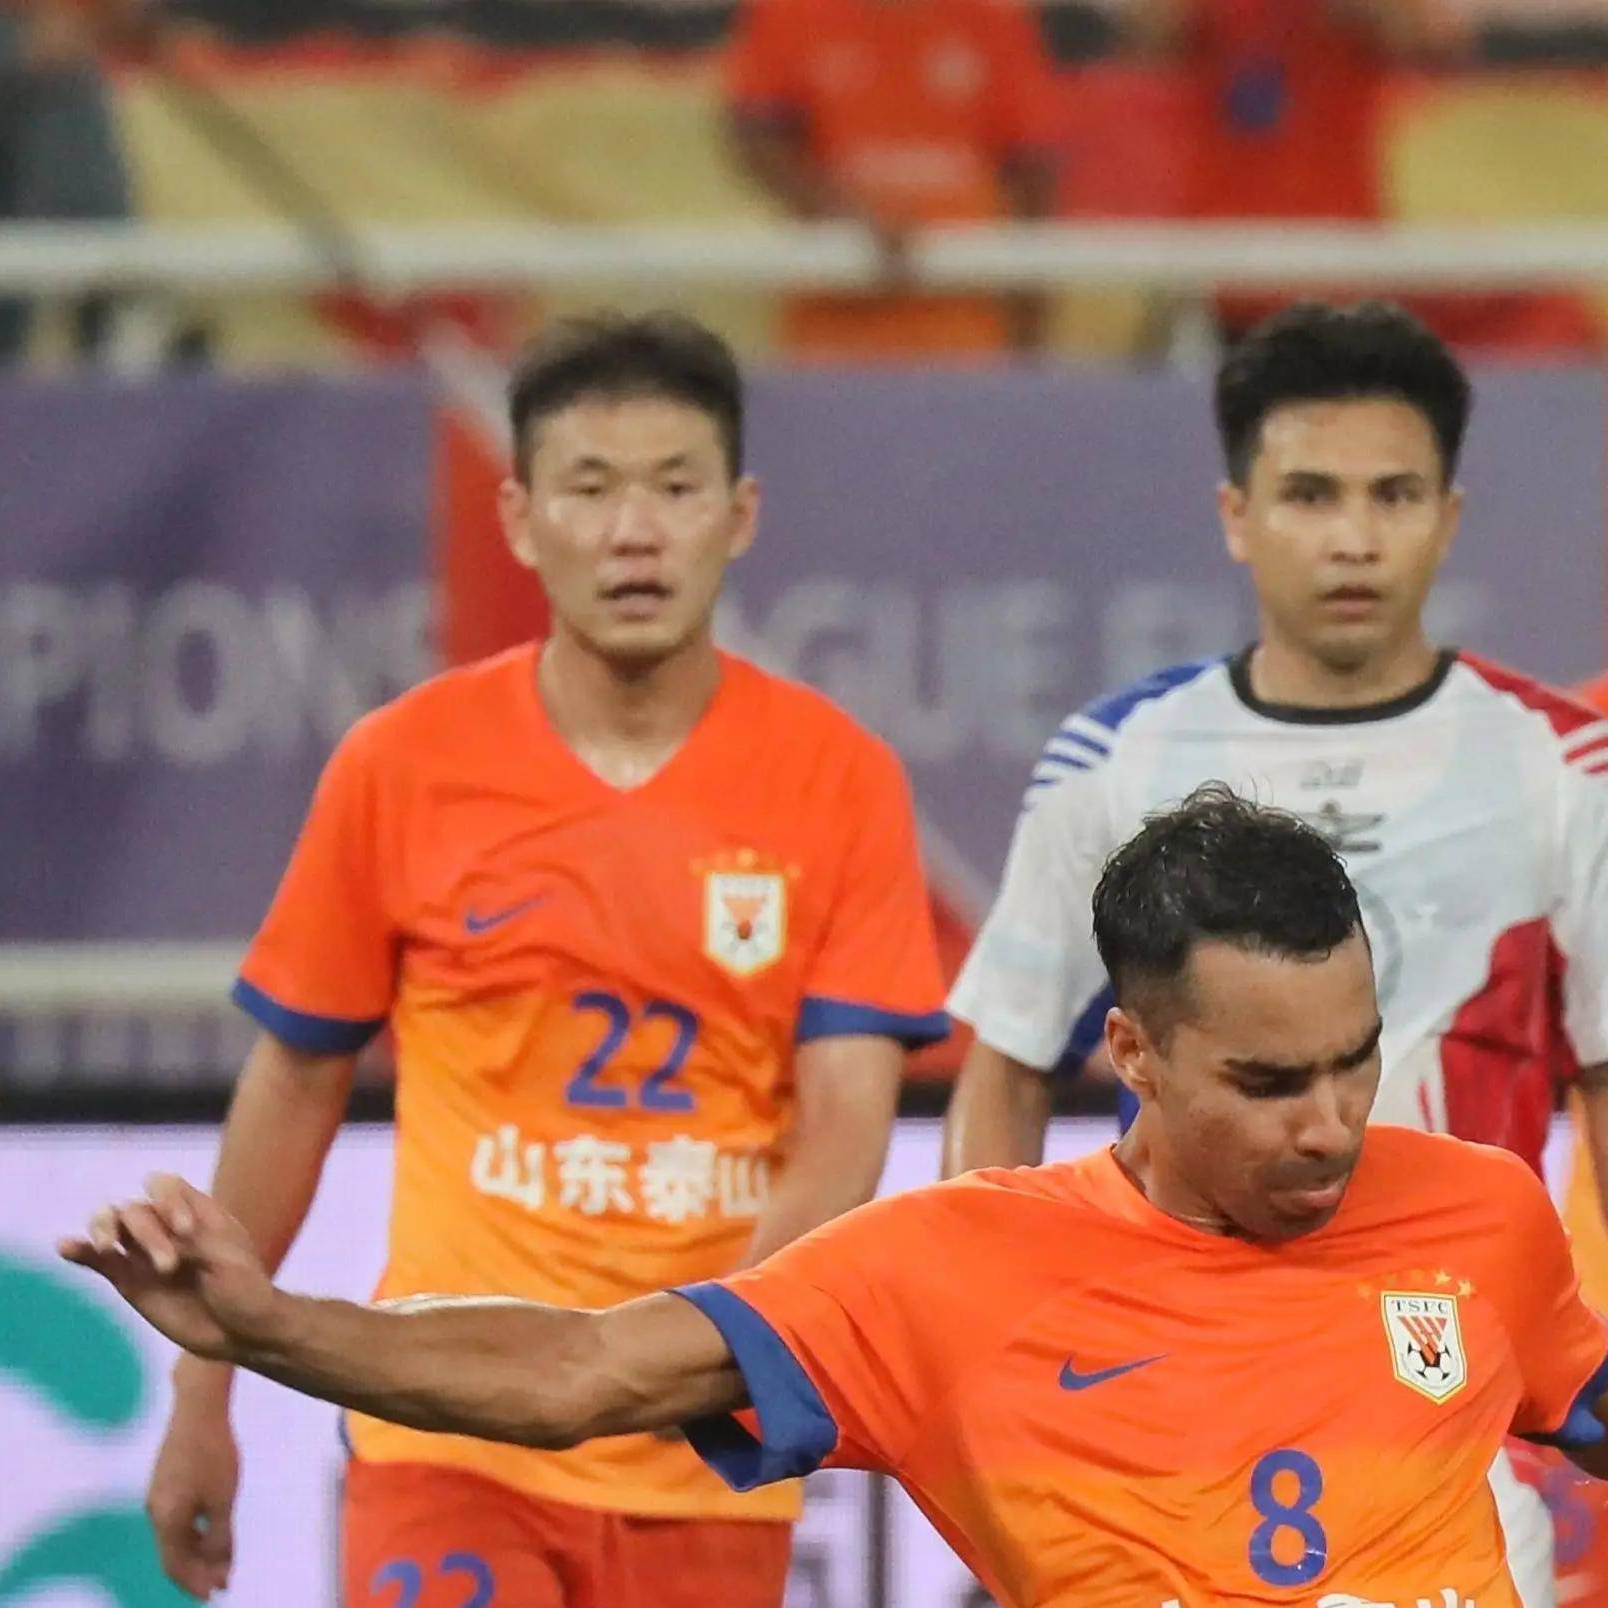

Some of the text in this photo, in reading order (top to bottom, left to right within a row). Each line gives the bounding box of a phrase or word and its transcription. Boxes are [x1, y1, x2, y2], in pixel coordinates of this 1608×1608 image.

[563, 989, 703, 1112] 22
[470, 1124, 773, 1222] 山东泰山
[1247, 1446, 1329, 1588] 8
